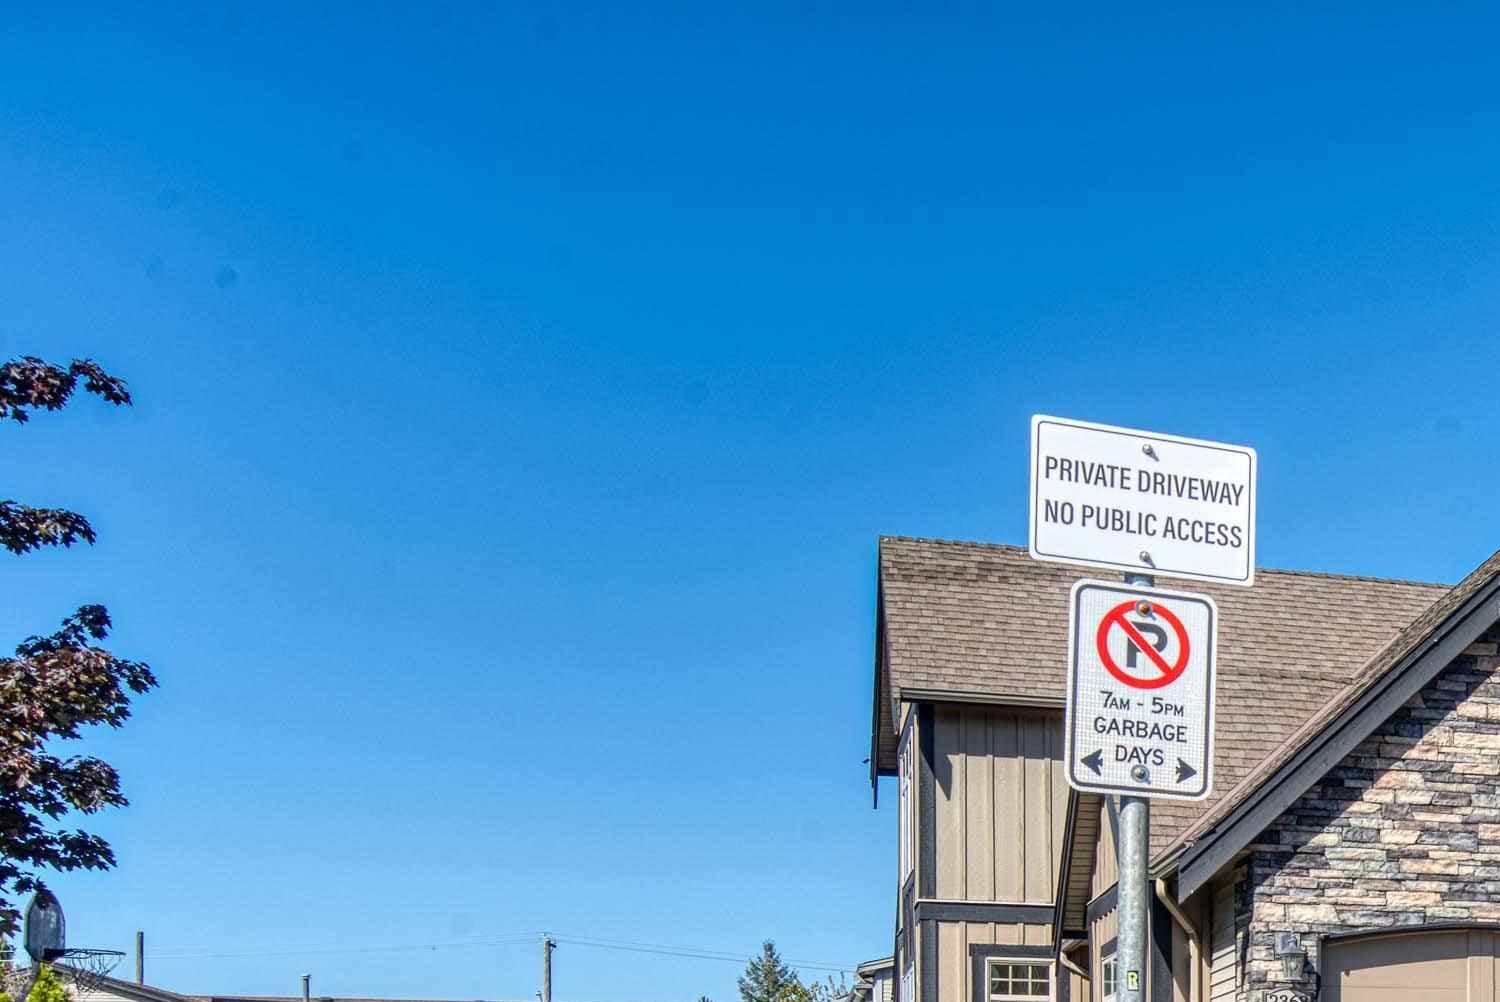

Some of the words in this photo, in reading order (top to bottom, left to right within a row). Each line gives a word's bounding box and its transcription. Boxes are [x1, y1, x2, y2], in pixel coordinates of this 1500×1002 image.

[1045, 456, 1131, 490] PRIVATE
[1138, 470, 1244, 506] DRIVEWAY
[1044, 499, 1074, 524] NO
[1082, 504, 1157, 536] PUBLIC
[1163, 516, 1242, 548] ACCESS
[1100, 690, 1130, 711] 7AM
[1151, 697, 1185, 717] 5PM
[1094, 716, 1188, 743] GARBAGE
[1115, 745, 1164, 766] DAYS
